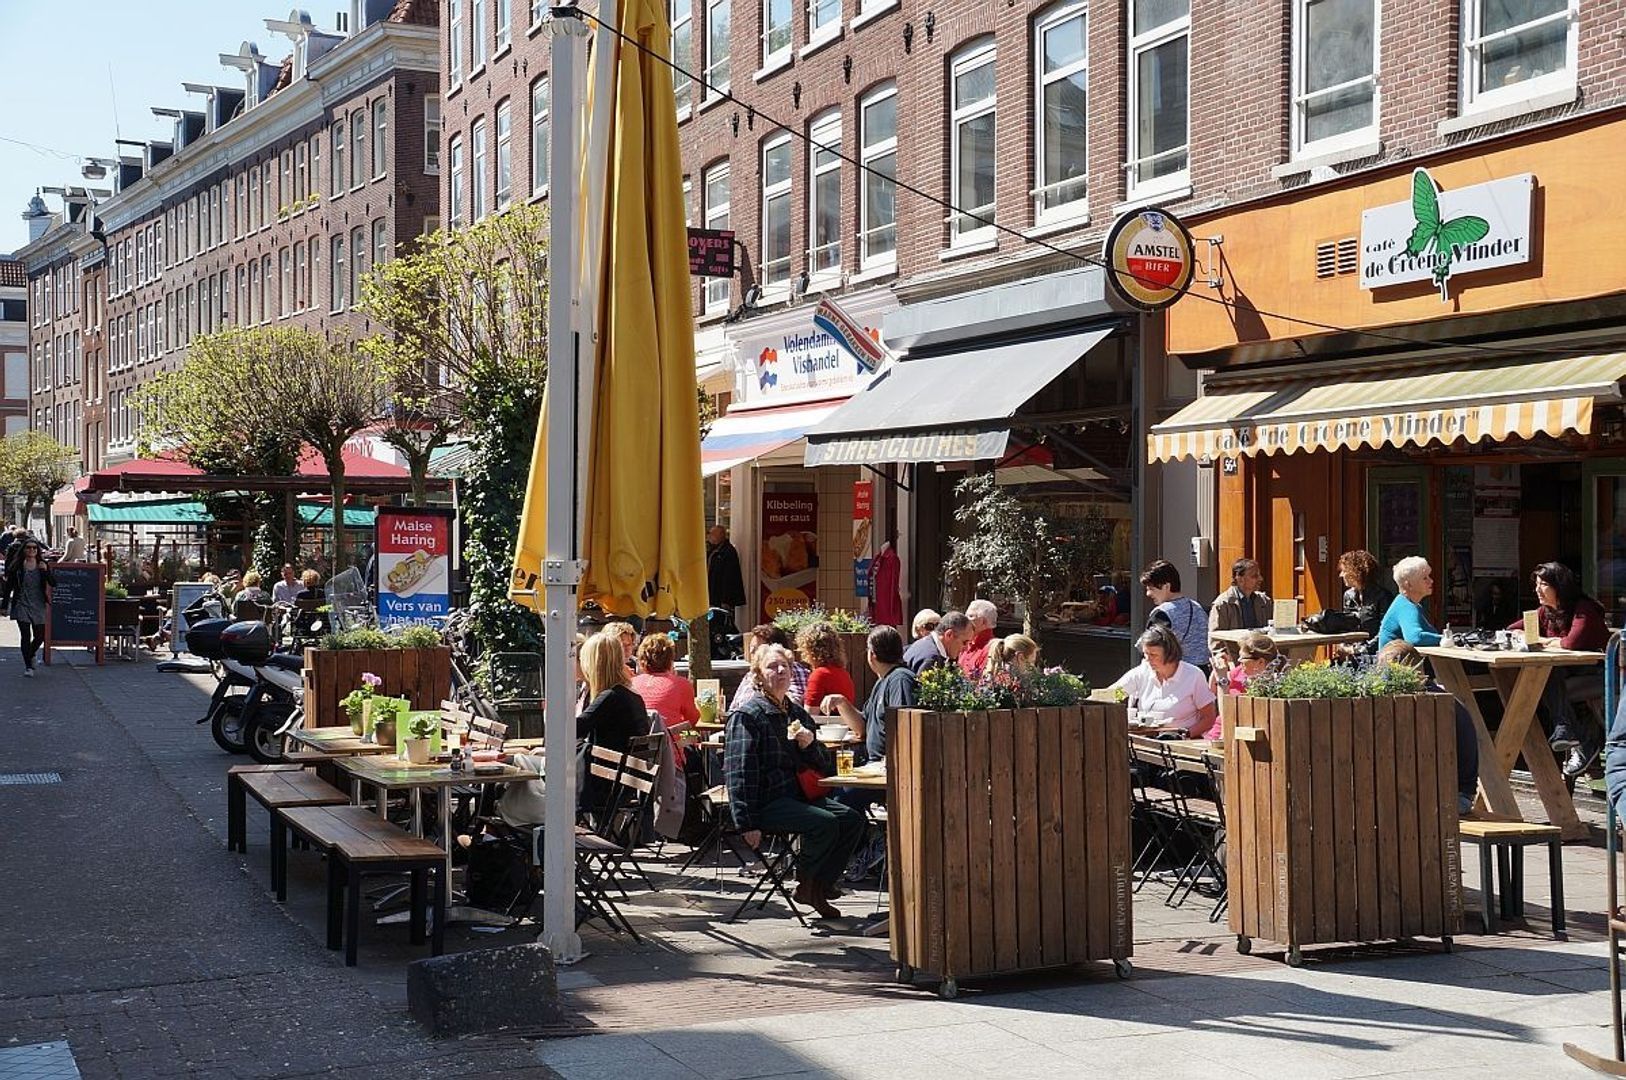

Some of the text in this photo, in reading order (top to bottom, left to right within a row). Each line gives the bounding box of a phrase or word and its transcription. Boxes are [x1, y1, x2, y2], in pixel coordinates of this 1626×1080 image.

[1134, 244, 1180, 259] AMSTEL
[1365, 261, 1384, 278] de
[1452, 236, 1523, 262] Vlinder
[1144, 261, 1170, 272] BIER
[792, 348, 839, 374] Vishandel
[766, 500, 813, 511] Kibbeling
[769, 513, 811, 522] met saus
[394, 520, 433, 531] Malse
[391, 533, 436, 549] Haring
[386, 599, 442, 612] Vers van
